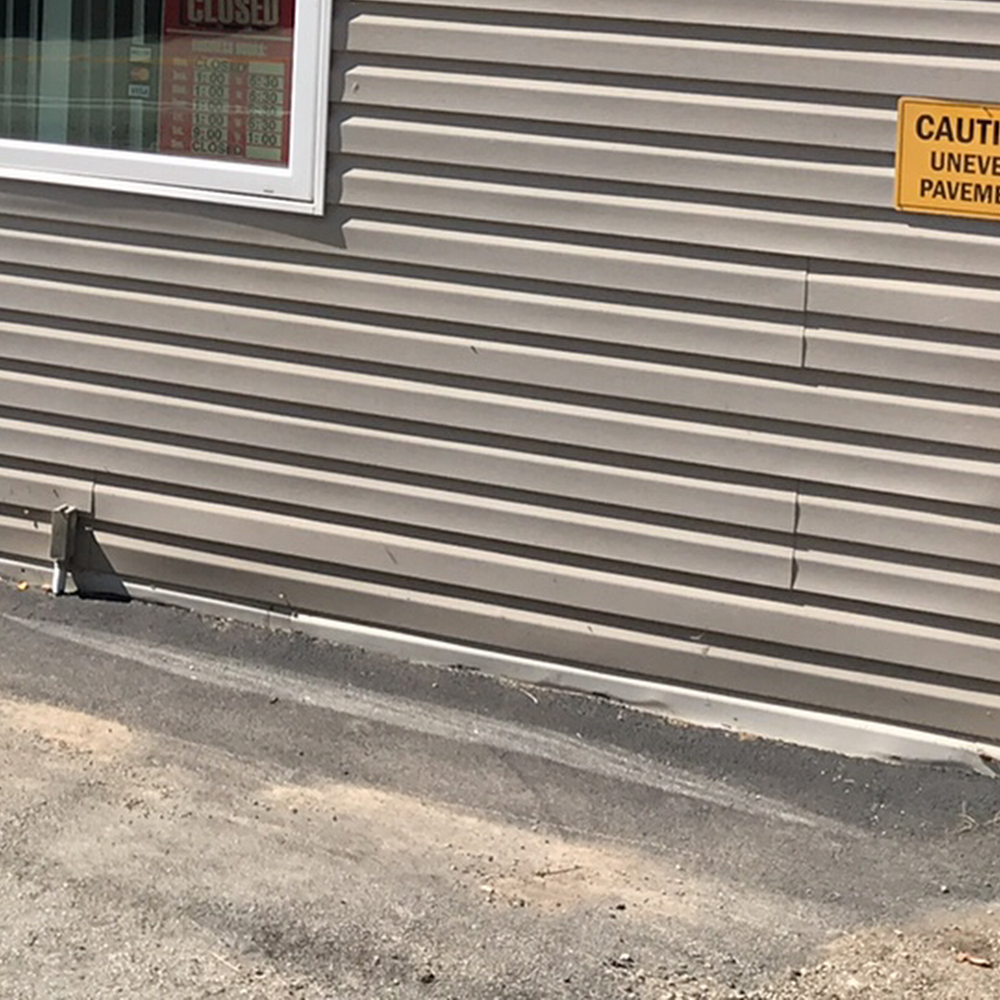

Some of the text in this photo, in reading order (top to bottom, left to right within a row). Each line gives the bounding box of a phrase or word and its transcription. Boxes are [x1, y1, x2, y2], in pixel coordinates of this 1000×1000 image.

[193, 126, 278, 146] 9:00 1:00
[916, 114, 1000, 146] CAUTI
[931, 151, 1000, 177] UNEVE
